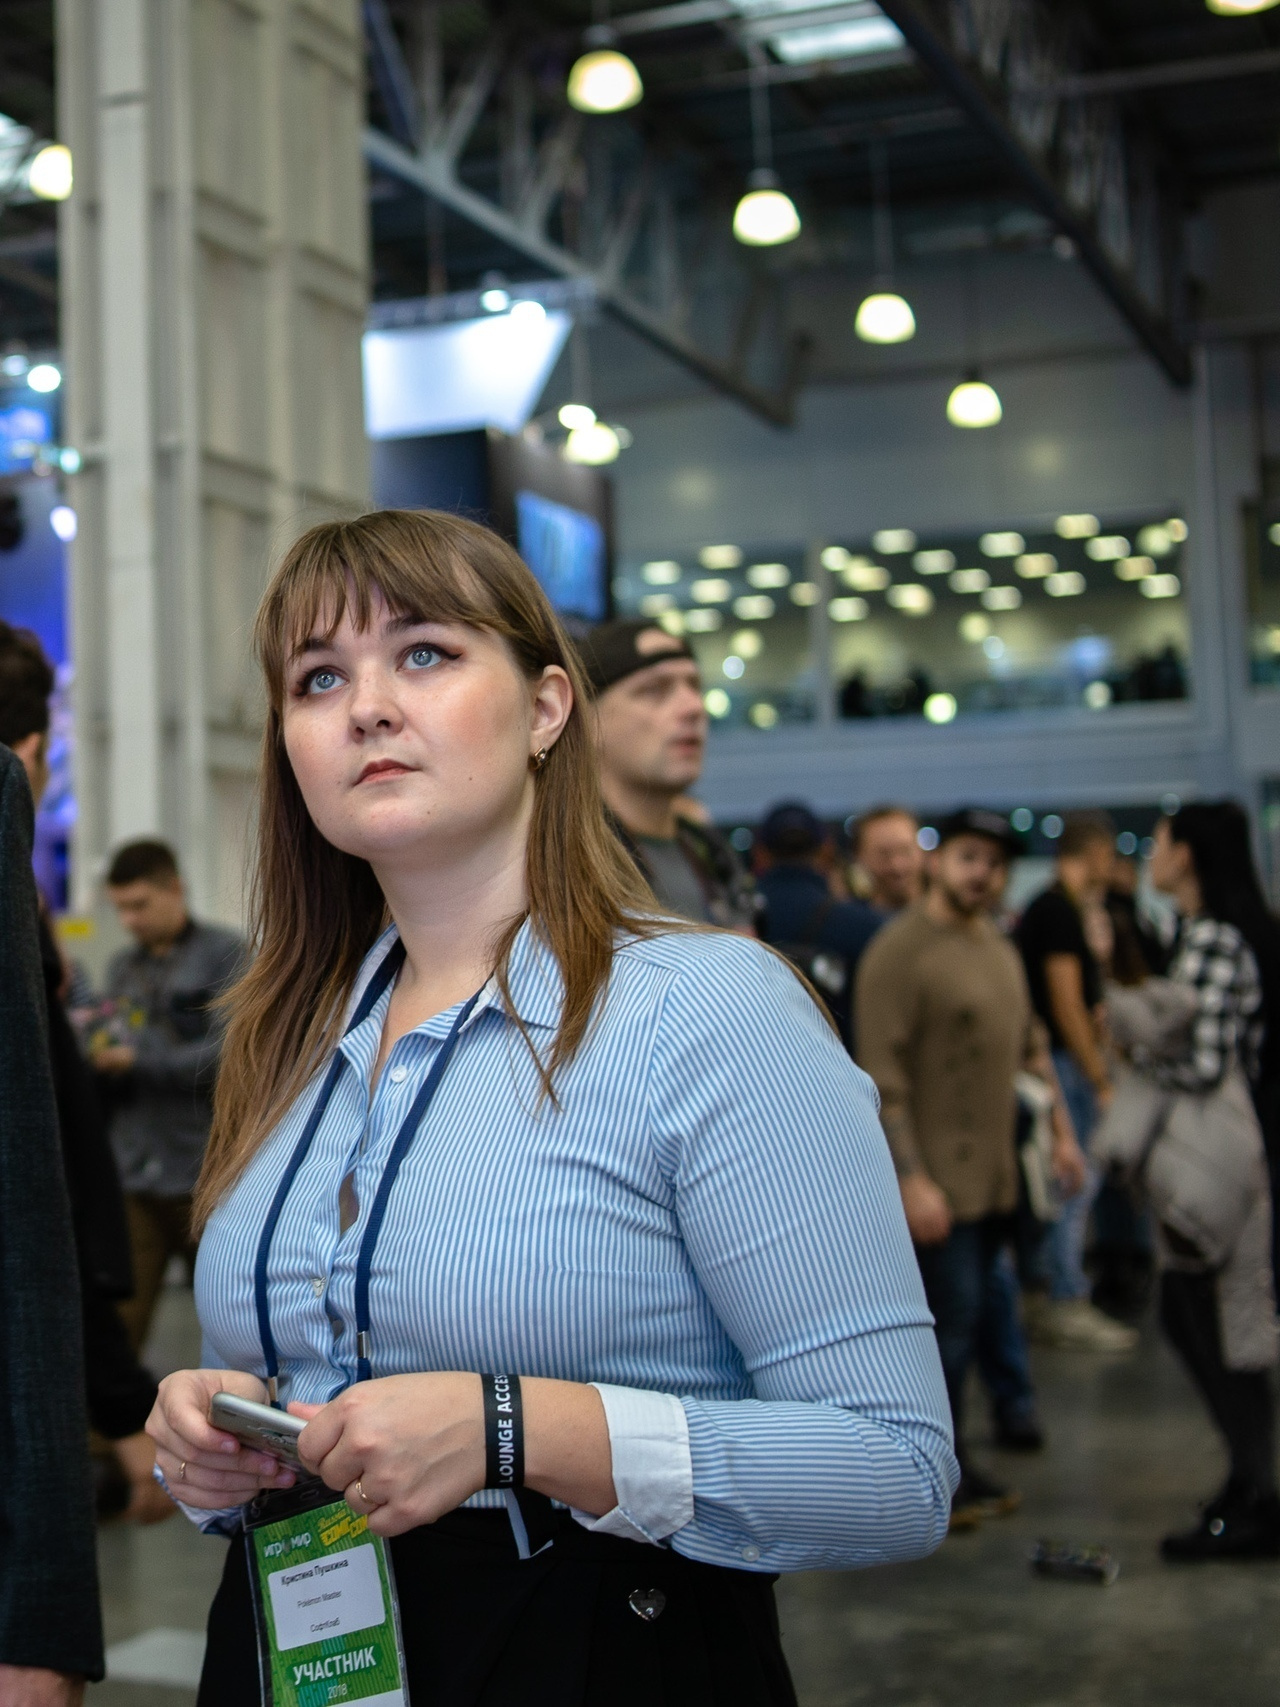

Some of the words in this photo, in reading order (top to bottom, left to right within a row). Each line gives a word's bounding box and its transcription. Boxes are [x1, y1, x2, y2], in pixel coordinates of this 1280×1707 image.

[494, 1374, 513, 1413] ACCES
[497, 1418, 515, 1483] LOUNGE
[314, 1559, 349, 1577] Пушкина
[293, 1645, 377, 1686] УЧАСТНИК
[327, 1683, 348, 1700] 2018
